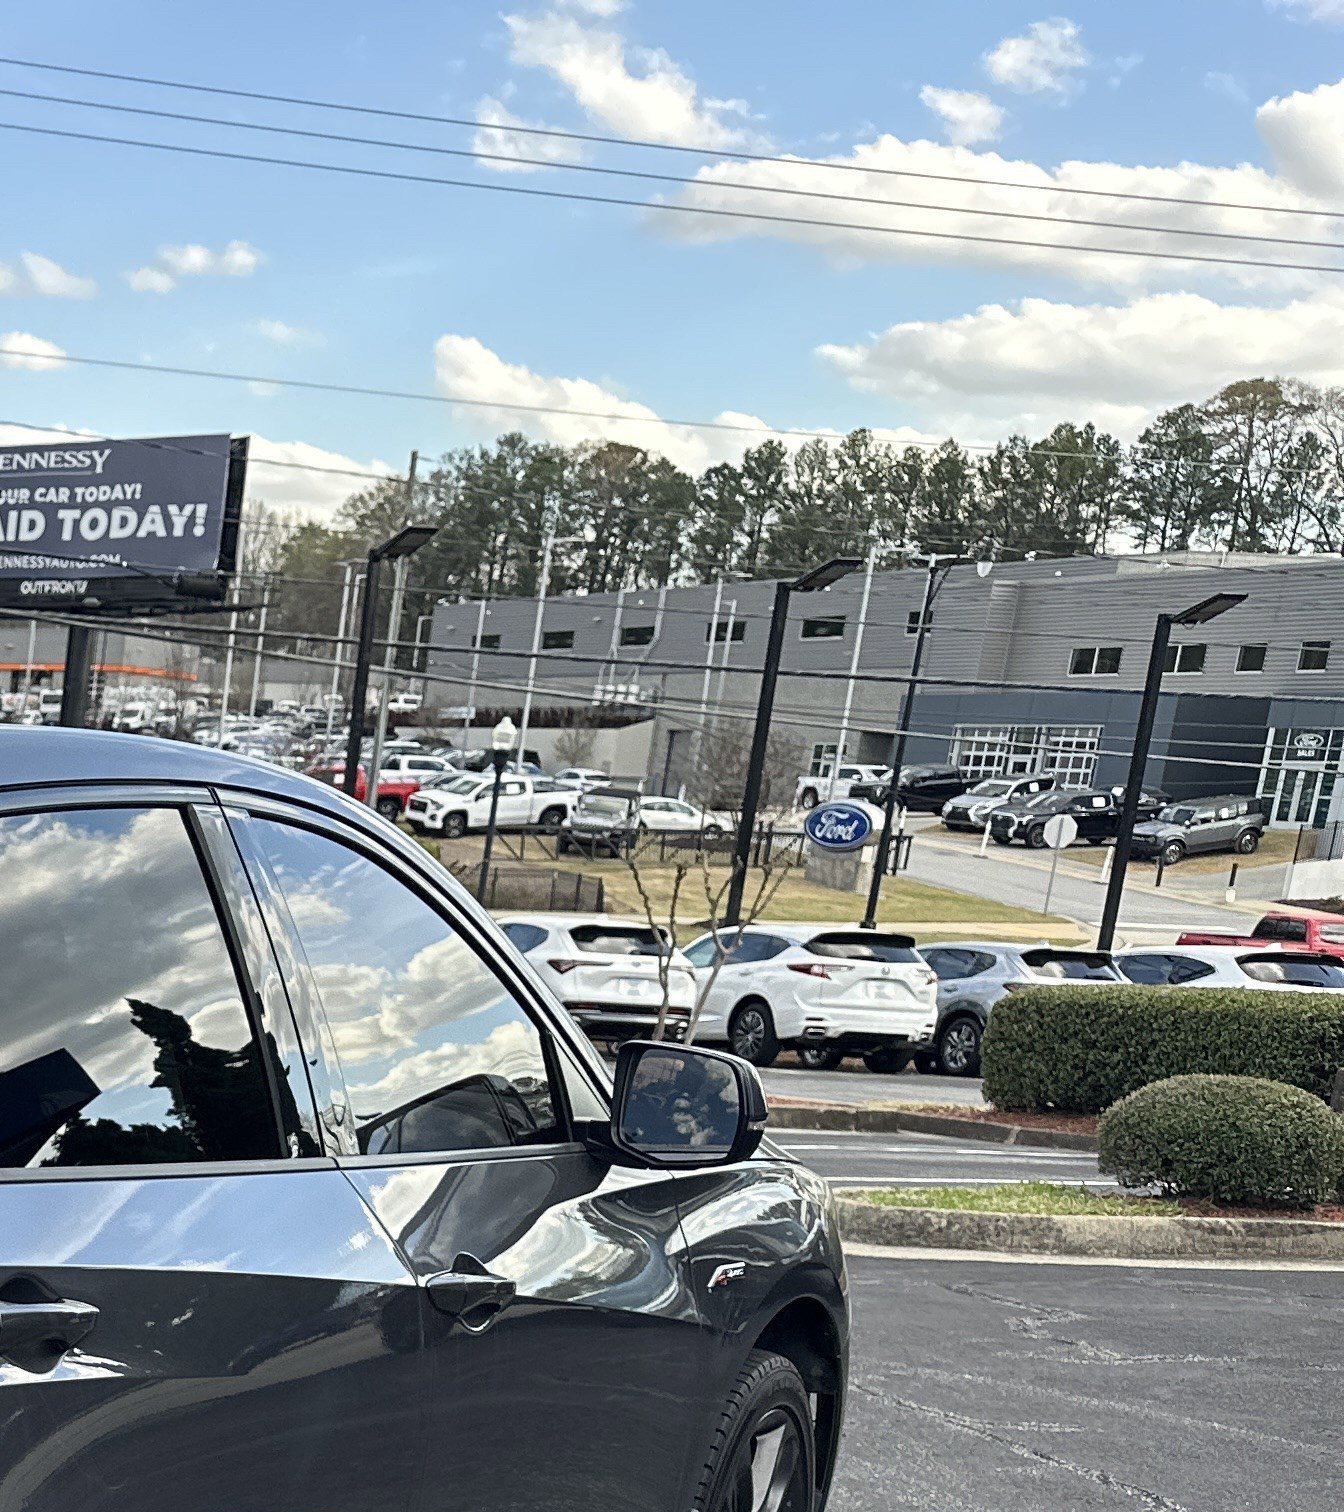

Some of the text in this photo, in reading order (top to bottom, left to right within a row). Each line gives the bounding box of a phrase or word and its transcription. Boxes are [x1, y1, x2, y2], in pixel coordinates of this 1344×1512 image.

[33, 486, 71, 503] CAR
[74, 483, 143, 503] TODAY!
[57, 503, 208, 541] TODAY!
[815, 810, 860, 841] Ford
